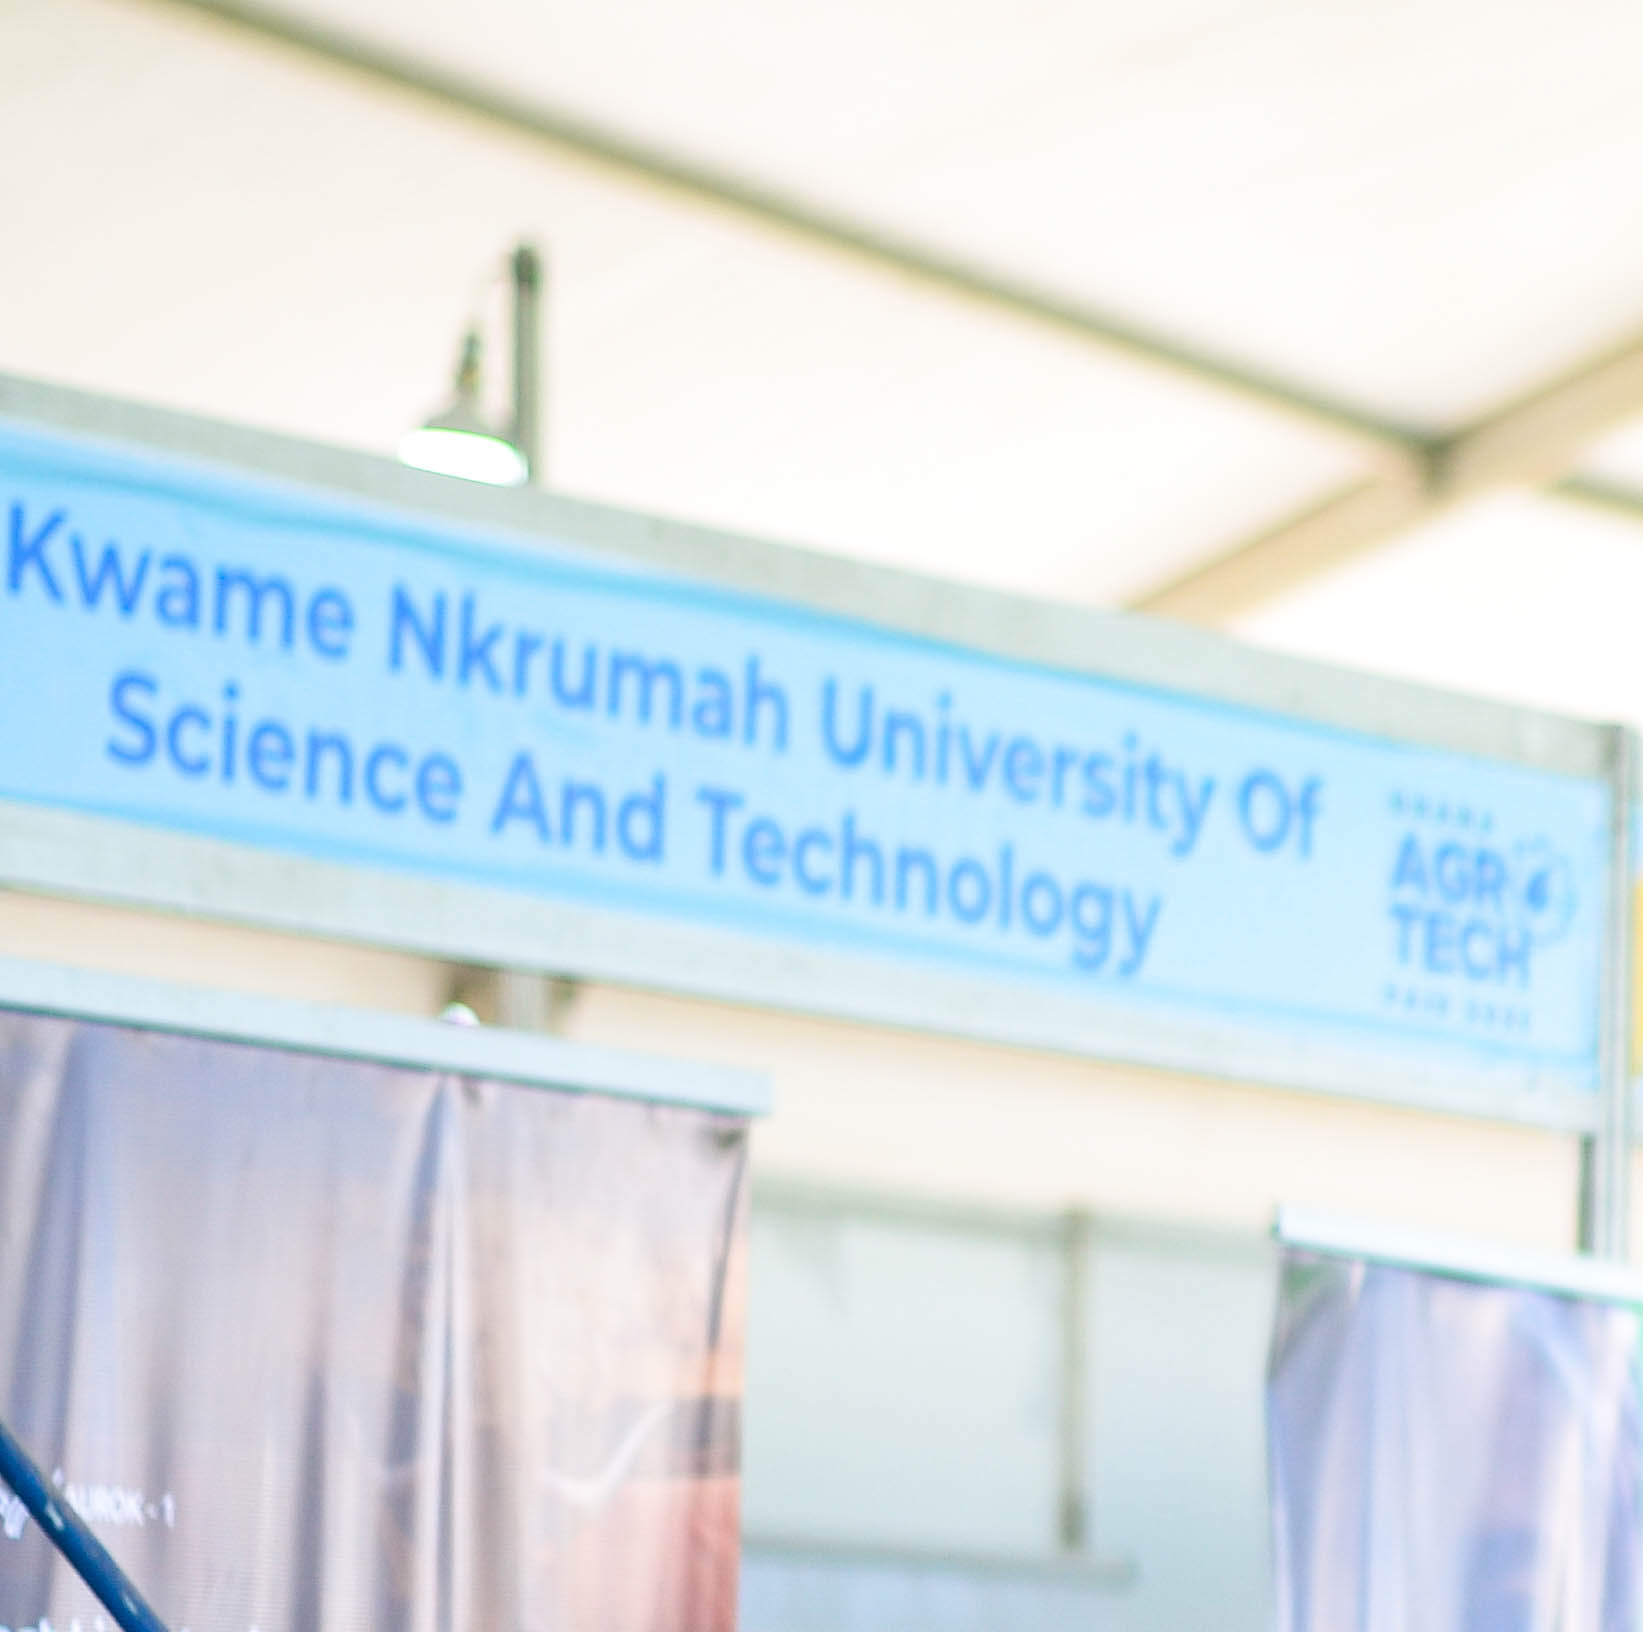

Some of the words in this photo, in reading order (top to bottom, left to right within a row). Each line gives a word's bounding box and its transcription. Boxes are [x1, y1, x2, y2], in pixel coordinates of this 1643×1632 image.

[6, 497, 356, 660] Kwame
[389, 579, 790, 753] Nkrumah
[820, 670, 1216, 860] University
[1236, 767, 1326, 861] Of
[105, 668, 464, 825] Science
[488, 748, 669, 867] And
[695, 786, 1164, 977] Technology
